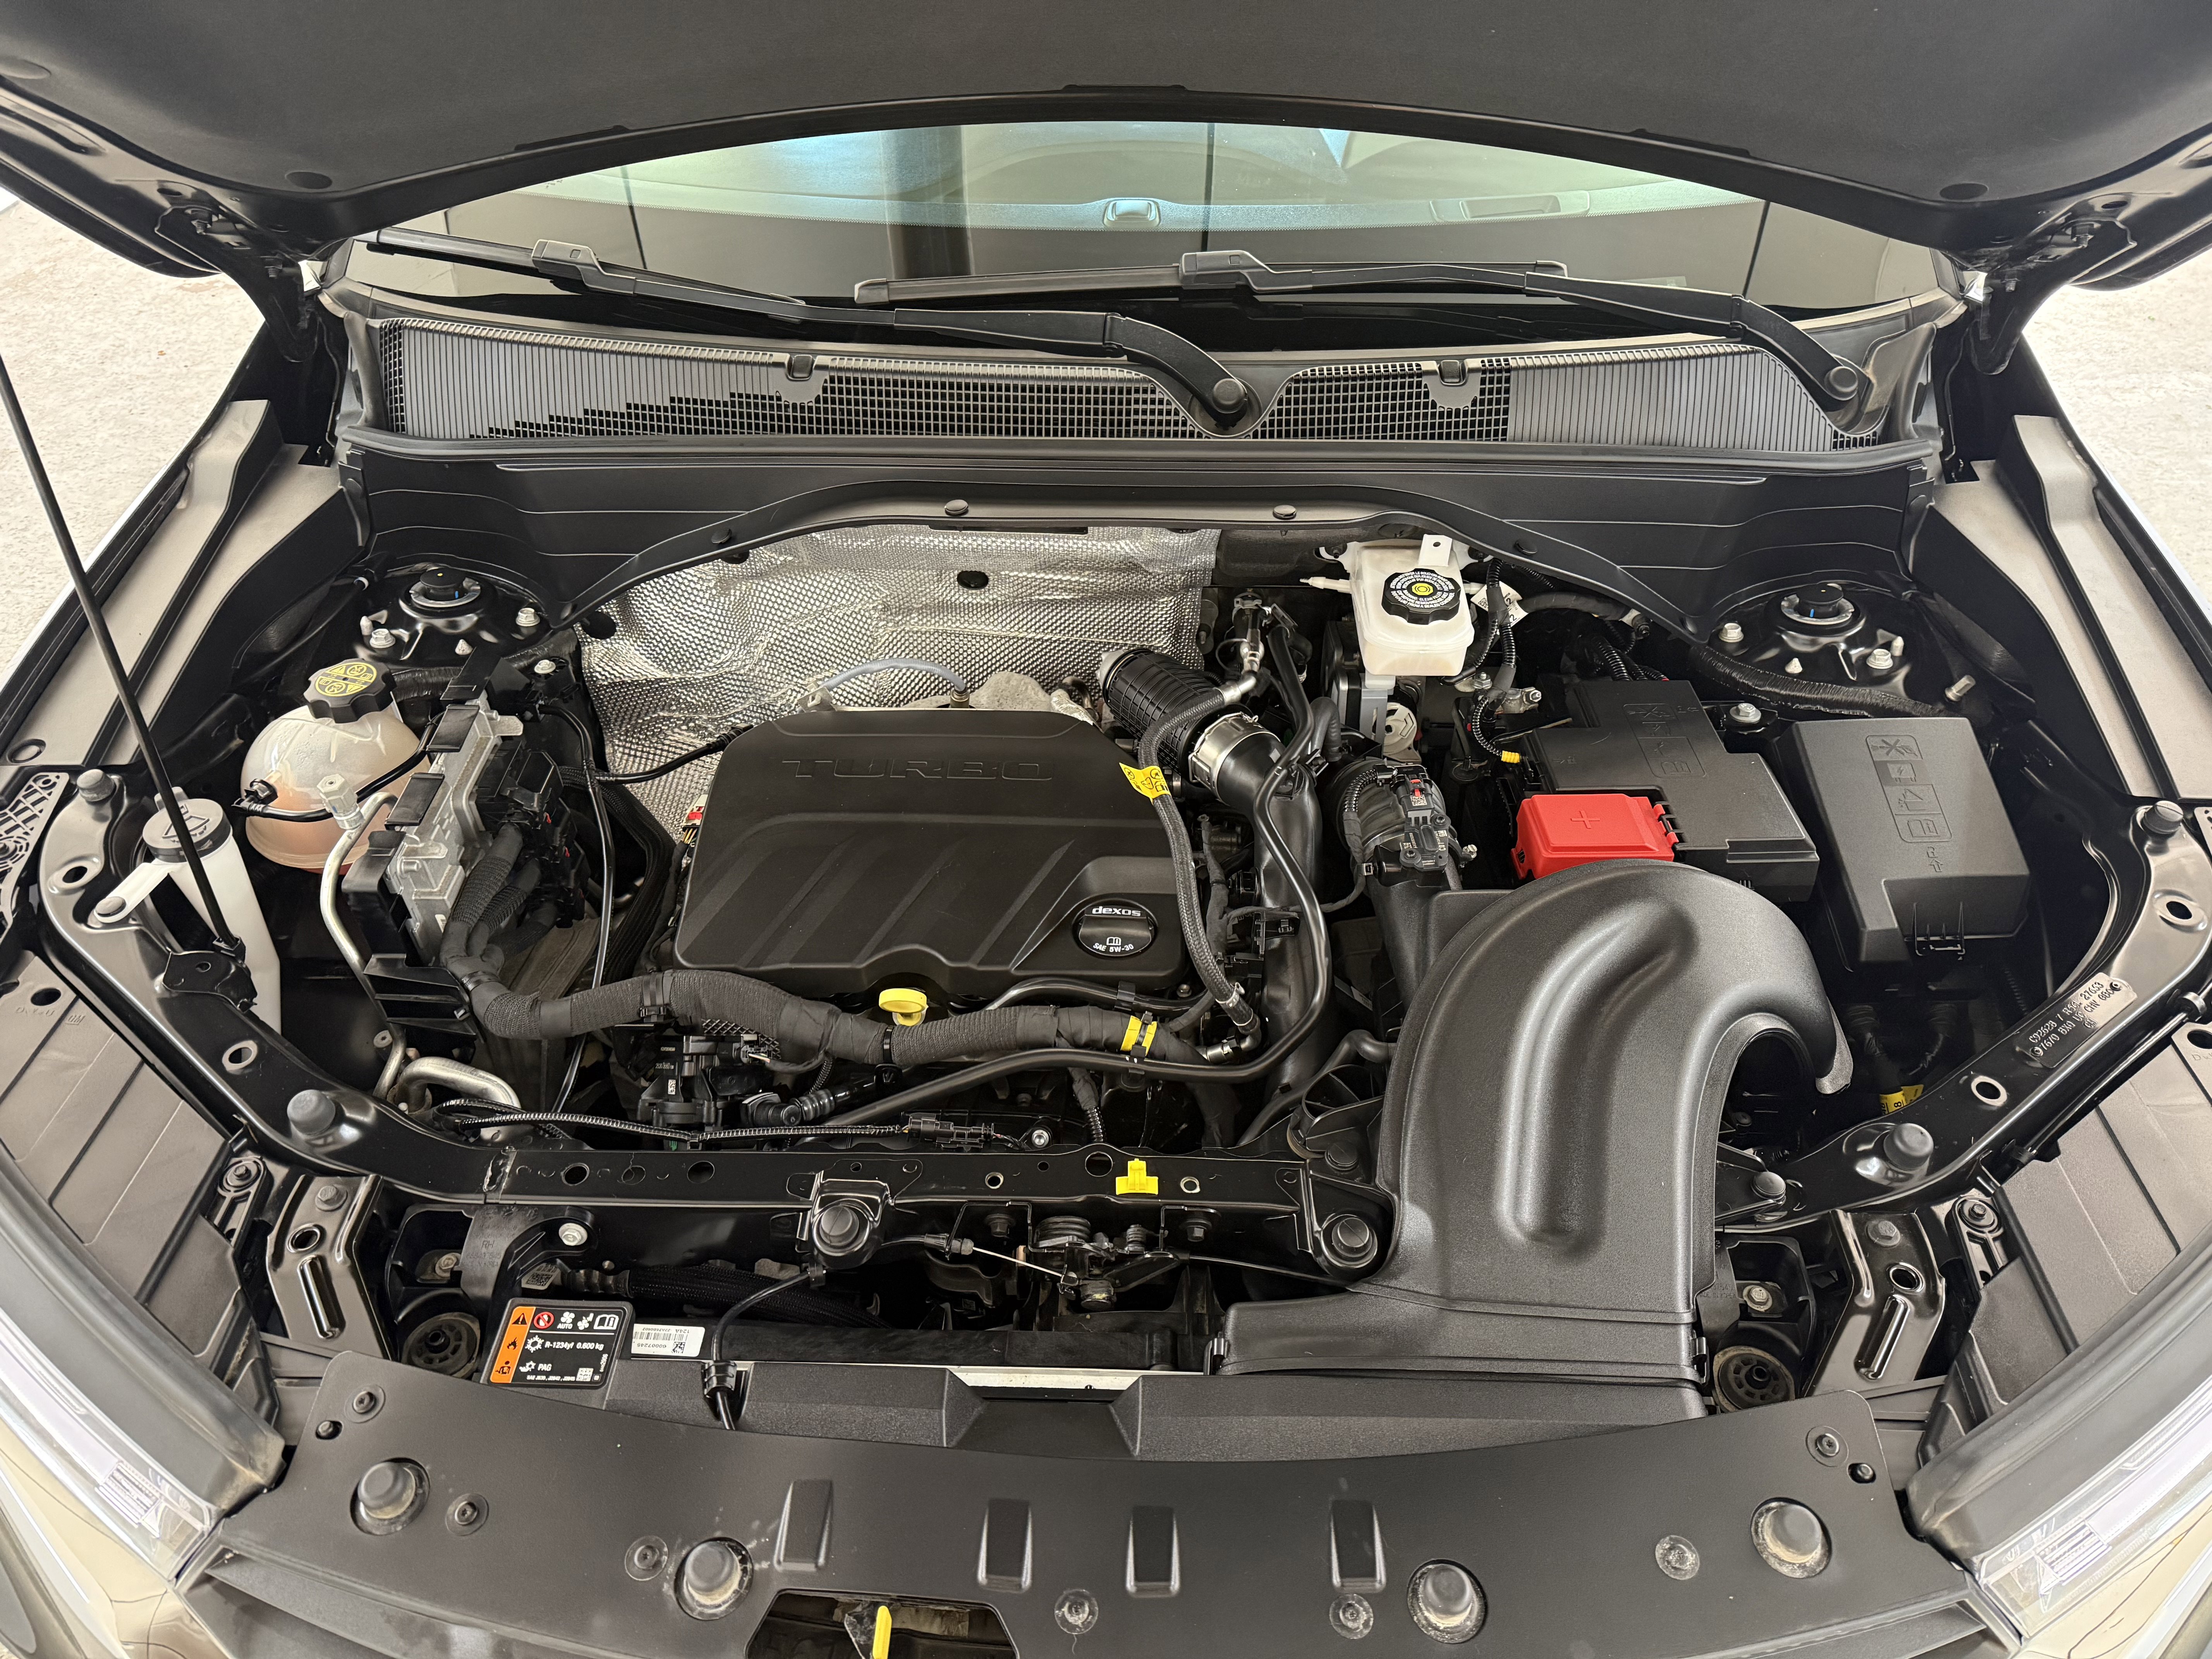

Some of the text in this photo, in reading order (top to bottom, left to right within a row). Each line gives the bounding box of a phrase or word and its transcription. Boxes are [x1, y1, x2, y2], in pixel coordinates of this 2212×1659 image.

[781, 758, 1055, 781] TURBO
[1092, 906, 1141, 917] dexos
[1093, 943, 1134, 953] SAE 5W-30
[481, 1240, 495, 1250] RH
[544, 1341, 574, 1350] R-1234yf
[538, 1363, 552, 1371] PAG
